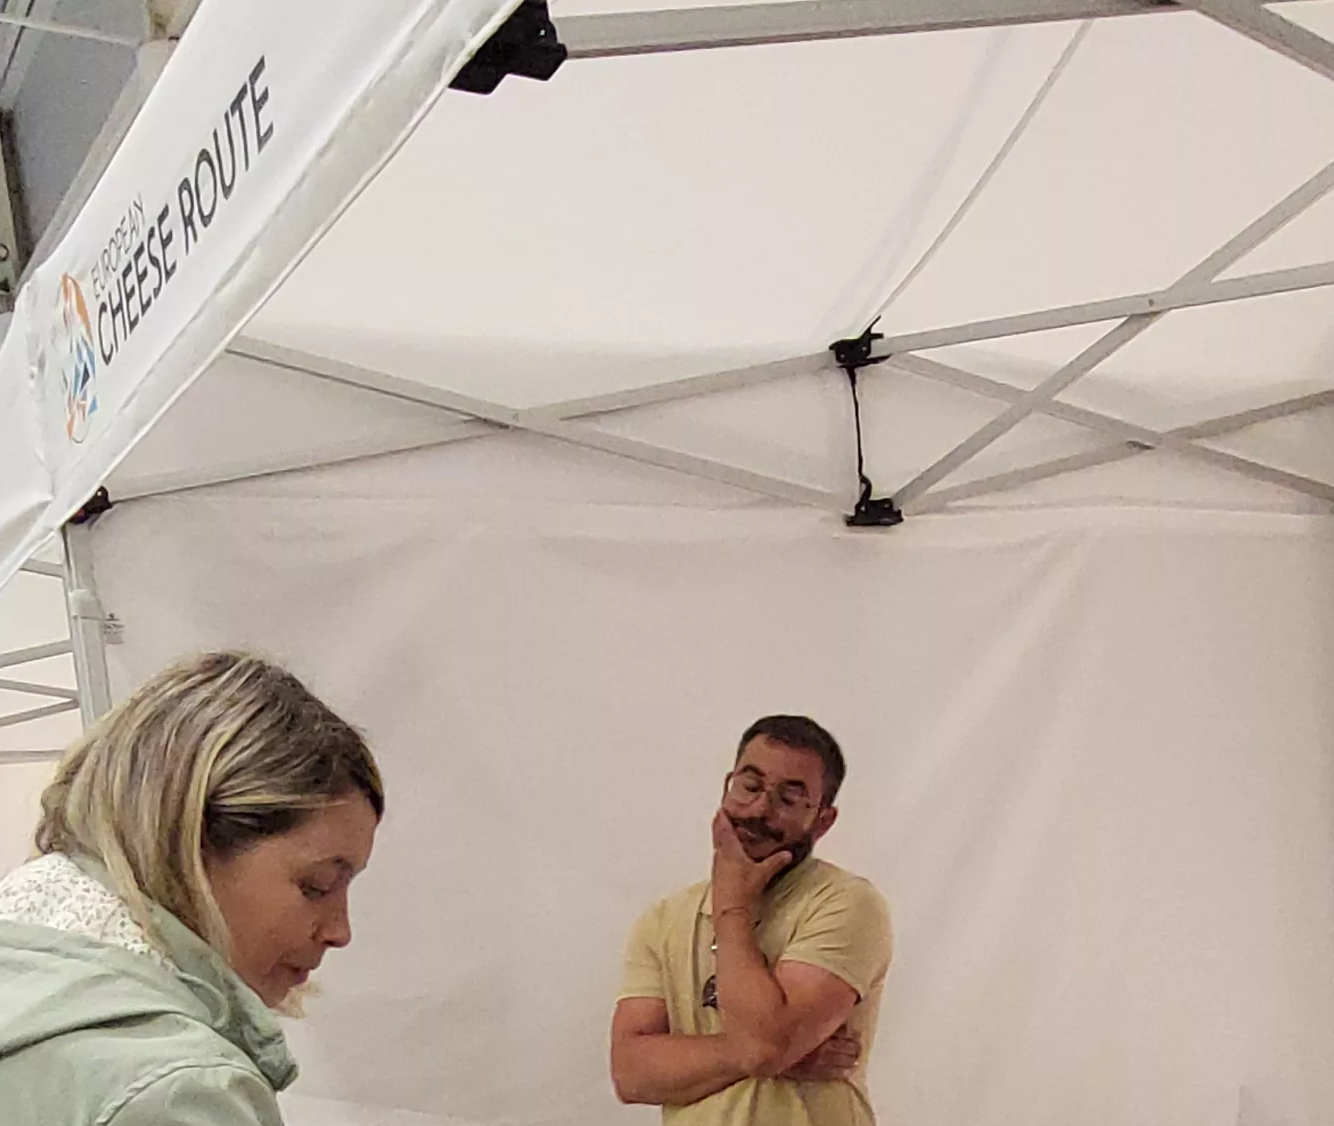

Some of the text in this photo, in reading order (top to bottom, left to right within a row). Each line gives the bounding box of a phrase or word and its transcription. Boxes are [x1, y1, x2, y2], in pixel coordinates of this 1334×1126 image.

[90, 191, 146, 299] EUROPEAN
[97, 54, 275, 366] CHEESE ROUTE
